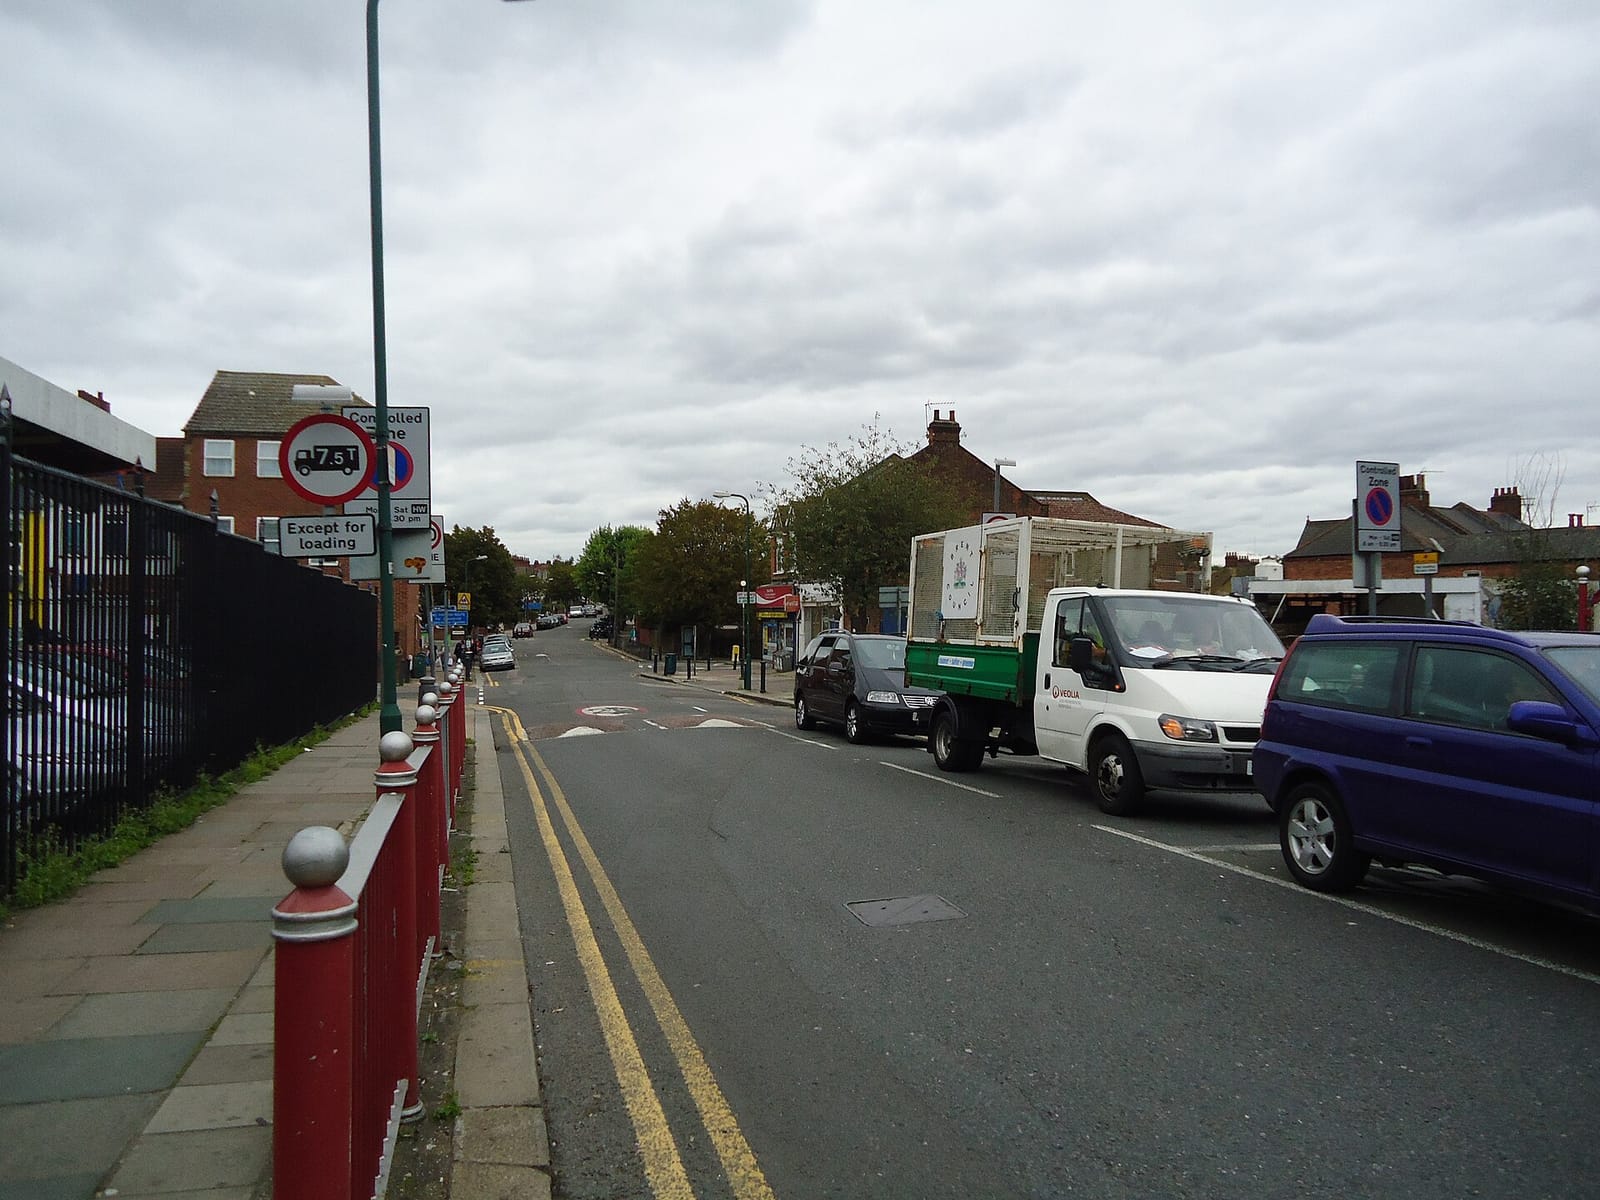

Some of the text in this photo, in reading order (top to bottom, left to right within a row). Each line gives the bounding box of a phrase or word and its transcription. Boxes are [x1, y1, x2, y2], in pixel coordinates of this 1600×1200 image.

[350, 412, 422, 423] Conolled
[1360, 465, 1397, 475] Controlled
[1369, 476, 1389, 487] Zone
[366, 506, 378, 514] Mo
[412, 505, 427, 514] HW
[287, 521, 366, 536] Except for
[300, 537, 356, 550] loading
[1060, 689, 1080, 699] VEOLIA
